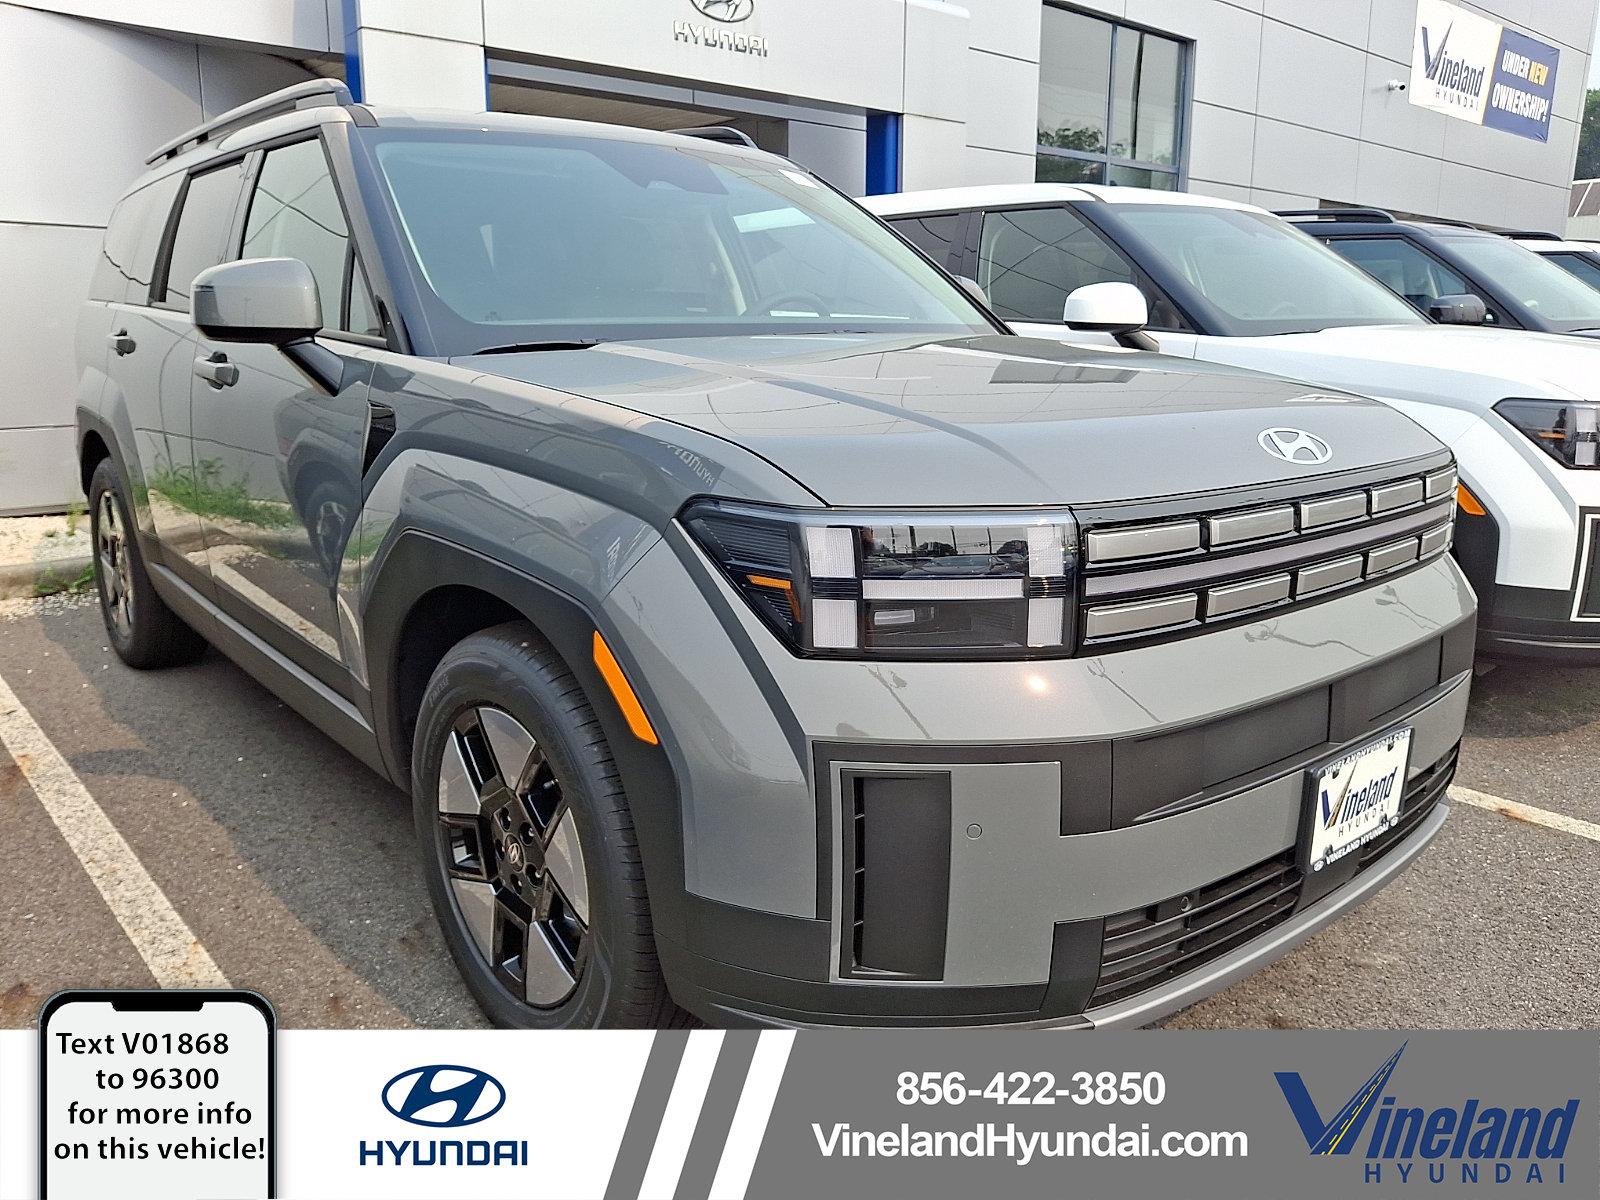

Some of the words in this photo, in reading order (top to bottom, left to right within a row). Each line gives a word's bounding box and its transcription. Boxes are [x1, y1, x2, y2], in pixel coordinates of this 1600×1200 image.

[673, 20, 769, 58] HYUNDAI
[1422, 20, 1486, 98] Vineland
[1501, 49, 1531, 80] UNDER
[1527, 62, 1549, 87] NEW
[1435, 89, 1479, 112] HYUNDAI
[1491, 82, 1550, 123] OWNERSHIP!
[1321, 758, 1398, 831] Vineland
[1338, 801, 1391, 838] HYUNDAI
